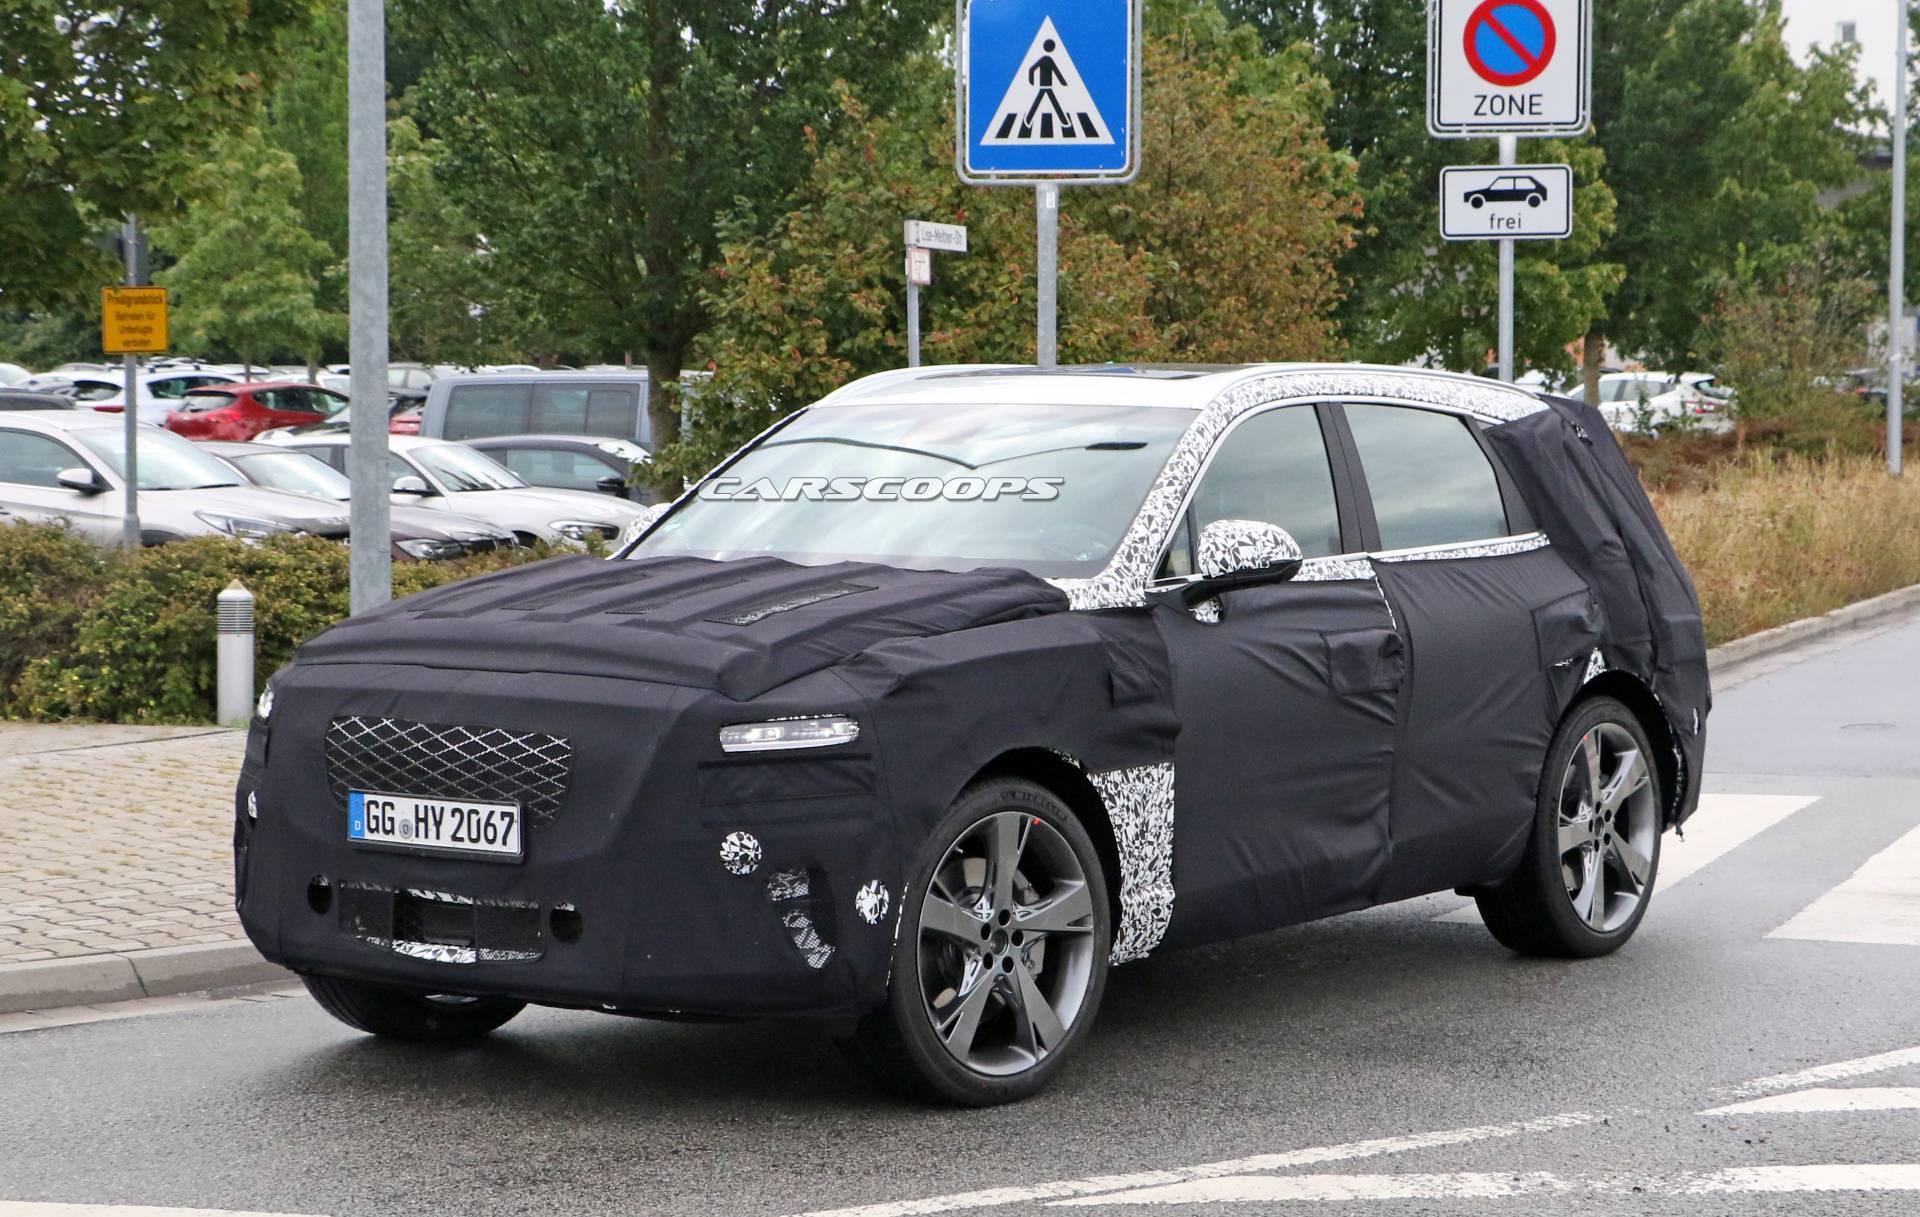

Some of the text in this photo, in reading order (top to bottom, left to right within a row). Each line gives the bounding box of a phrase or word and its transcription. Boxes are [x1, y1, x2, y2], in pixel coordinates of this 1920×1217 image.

[1473, 93, 1543, 116] ZONE
[1489, 212, 1522, 229] frei
[354, 819, 362, 831] D
[366, 799, 515, 846] GG HY 2067
